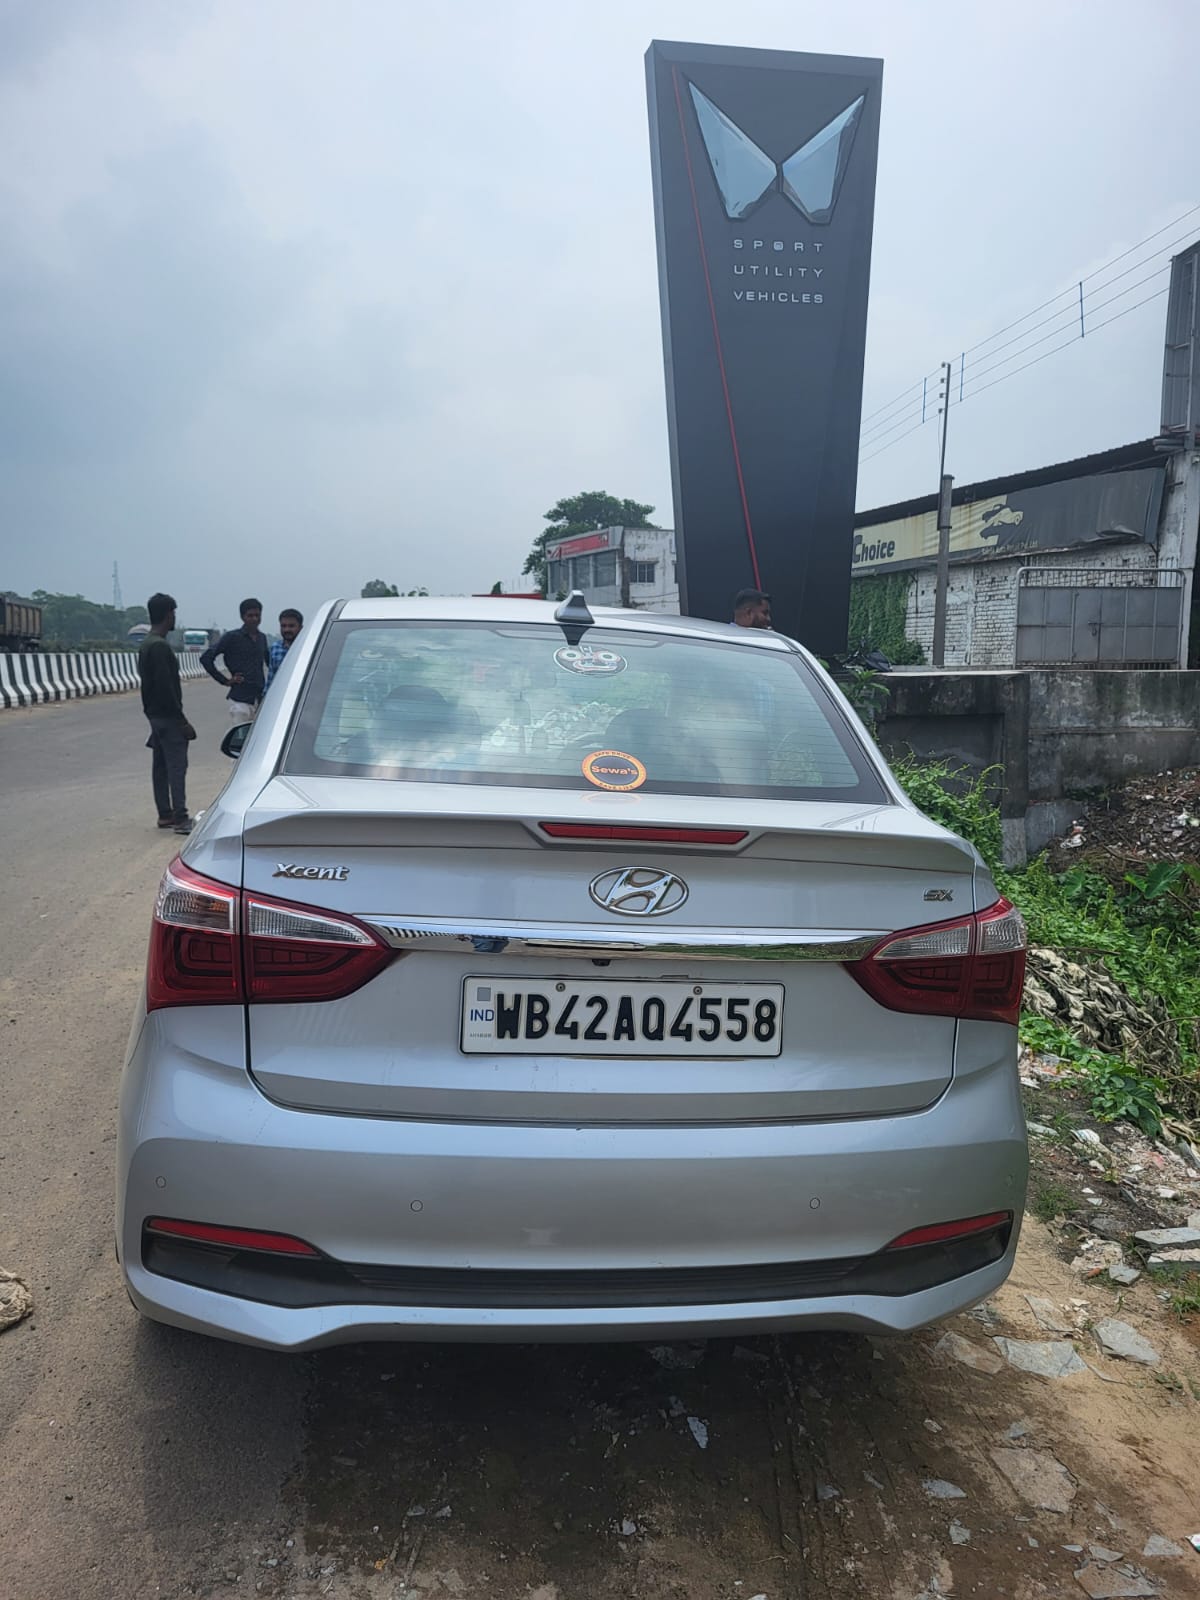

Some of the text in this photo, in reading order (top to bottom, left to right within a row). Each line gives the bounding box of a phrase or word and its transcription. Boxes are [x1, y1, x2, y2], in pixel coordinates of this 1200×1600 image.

[733, 239, 823, 253] SPORT
[733, 264, 824, 278] UTILITY
[733, 290, 824, 304] VEHICLES
[852, 534, 896, 564] Choice
[591, 765, 638, 775] Sewa's
[272, 862, 349, 881] Xcent
[470, 1008, 494, 1022] IND
